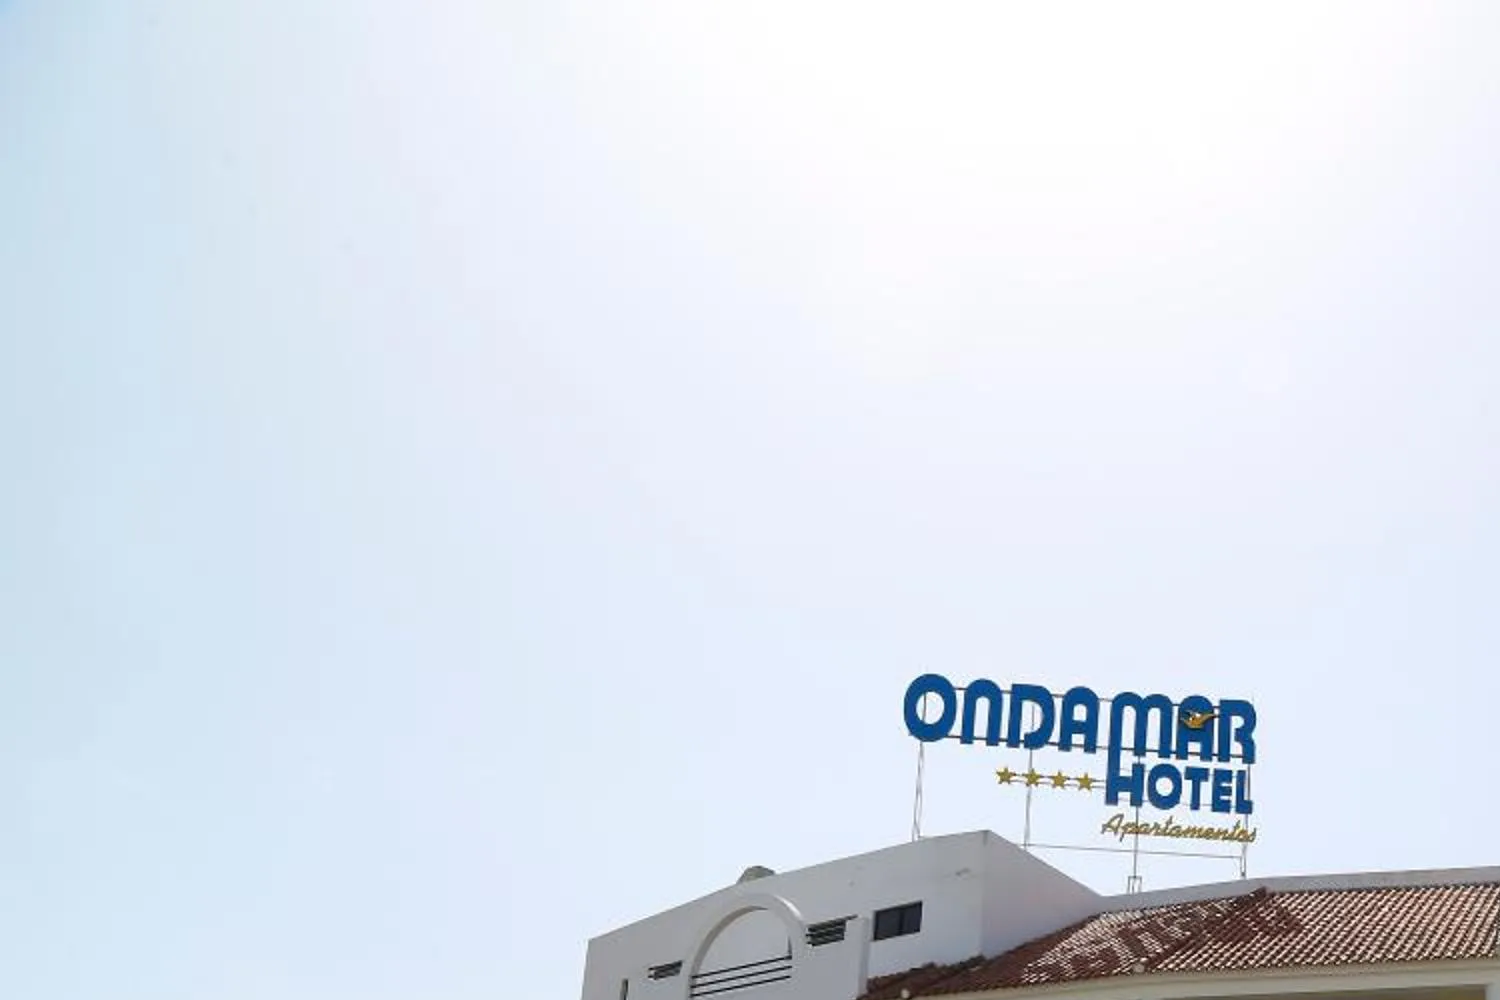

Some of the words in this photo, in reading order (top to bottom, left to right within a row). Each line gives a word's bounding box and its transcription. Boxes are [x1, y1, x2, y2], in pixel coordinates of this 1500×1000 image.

[903, 673, 1258, 764] ONDAMAR
[1104, 761, 1254, 815] HOTEL
[1100, 813, 1258, 842] Apartamentos
